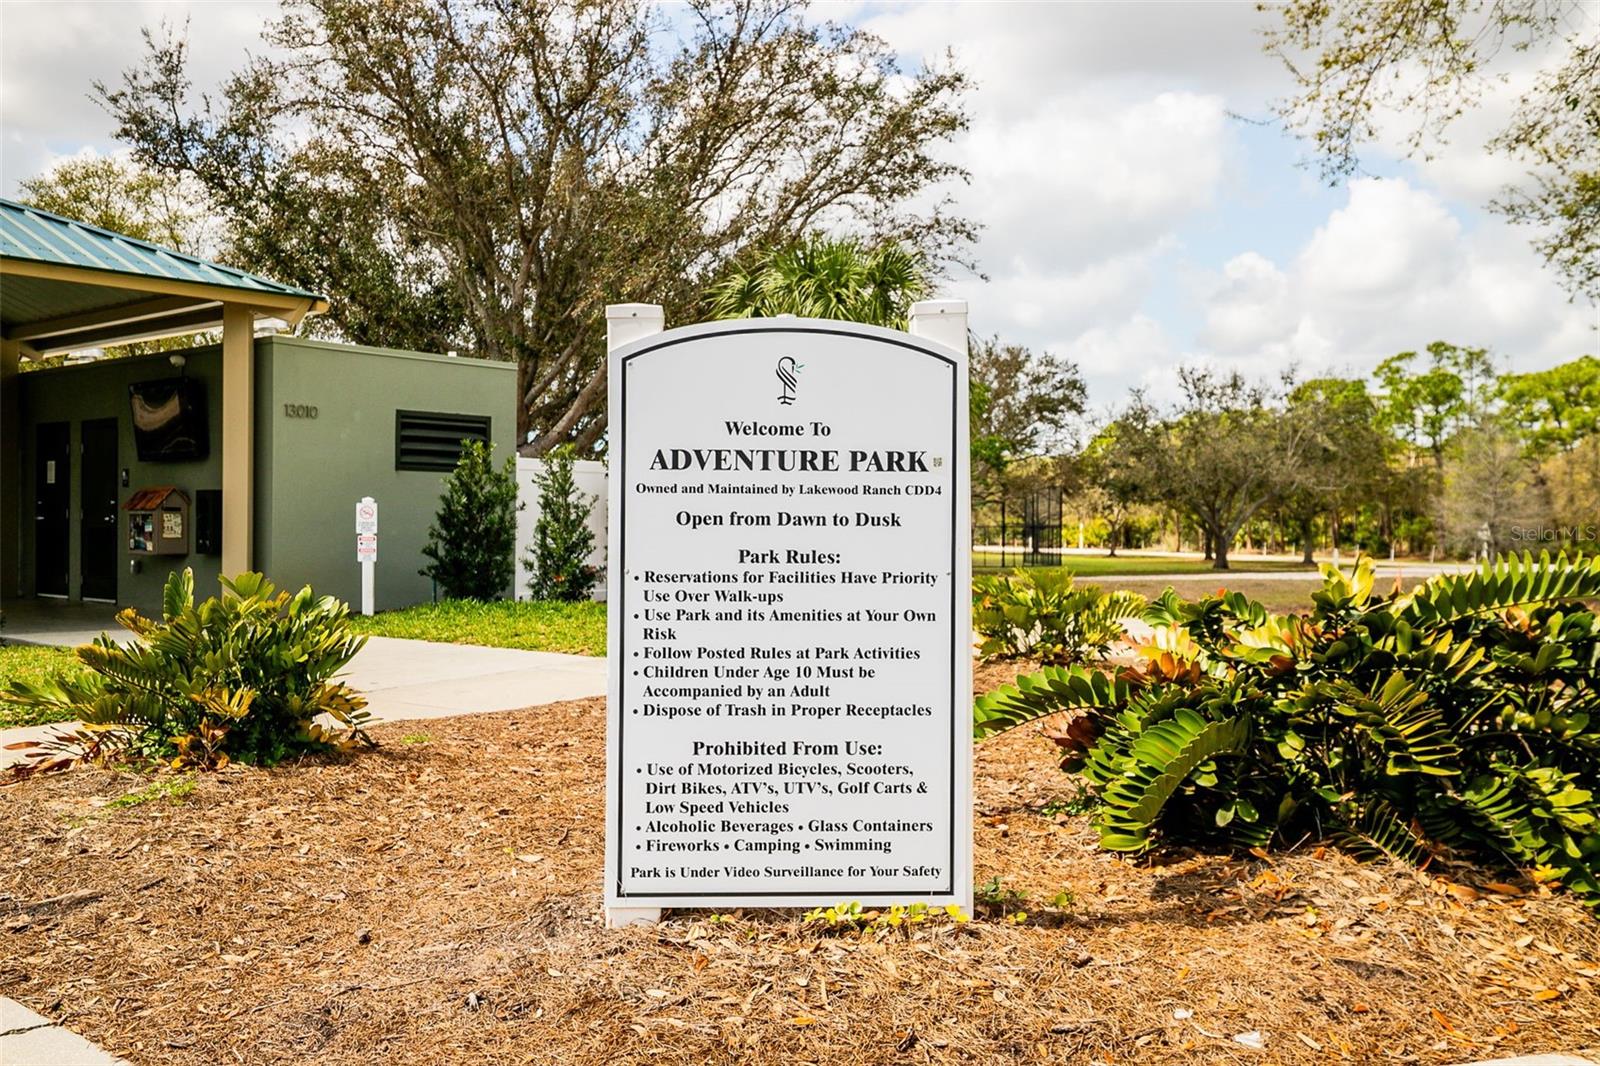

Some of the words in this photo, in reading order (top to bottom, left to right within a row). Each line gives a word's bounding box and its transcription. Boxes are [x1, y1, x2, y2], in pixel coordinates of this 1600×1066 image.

[283, 403, 319, 420] 13010
[724, 420, 805, 437] Welcome
[809, 421, 832, 437] To
[649, 448, 840, 473] ADVENTURE
[848, 449, 930, 473] PARK
[635, 482, 678, 494] Owned
[680, 483, 705, 494] and
[707, 483, 779, 495] Maintained
[781, 483, 796, 498] by
[798, 484, 859, 496] Lakewood
[862, 484, 902, 496] Ranch
[904, 484, 943, 496] CDD4
[675, 510, 724, 530] Open
[729, 510, 772, 527] from
[776, 511, 828, 527] Dawn
[832, 512, 850, 527] to
[855, 511, 902, 528] Dusk
[738, 548, 781, 565] Park
[785, 549, 841, 565] Rules:
[644, 570, 739, 584] Reservations
[742, 570, 765, 584] for
[768, 570, 837, 585] Facilities
[840, 571, 878, 585] Have
[881, 571, 939, 588] Priority
[643, 589, 671, 603] Use
[674, 589, 711, 603] Over
[713, 589, 784, 606] Walk-ups
[643, 608, 672, 622] Use
[675, 608, 711, 622] Park
[714, 608, 743, 622] and
[747, 608, 766, 622] its
[768, 608, 843, 622] Amenities
[846, 609, 862, 622] at
[864, 609, 900, 622] Your
[903, 609, 937, 623] Own
[642, 627, 677, 641] Risk
[643, 646, 692, 660] Follow
[696, 646, 746, 660] Posted
[750, 646, 792, 660] Rules
[795, 647, 811, 660] at
[814, 646, 850, 660] Park
[853, 646, 921, 660] Activities
[643, 665, 709, 679] Children
[713, 665, 760, 679] Under
[762, 665, 791, 682] Age
[796, 665, 813, 679] 10
[816, 665, 854, 679] Must
[858, 665, 876, 679] be
[642, 684, 743, 701] Accompanied
[746, 684, 764, 701] by
[767, 687, 786, 698] an
[789, 684, 831, 698] Adult
[643, 703, 702, 720] Dispose
[705, 703, 723, 717] of
[724, 703, 767, 717] Trash
[771, 703, 786, 717] in
[790, 703, 842, 720] Proper
[845, 703, 932, 720] Receptacles
[692, 740, 787, 757] Prohibited
[792, 740, 839, 756] From
[844, 740, 883, 756] Use:
[646, 762, 674, 776] Use
[677, 762, 695, 776] of
[697, 762, 774, 776] Motorized
[777, 762, 843, 779] Bicycles,
[846, 762, 914, 778] Scooters,
[645, 781, 677, 795] Dirt
[681, 781, 727, 797] Bikes,
[837, 781, 871, 795] Golf
[873, 781, 913, 795] Carts
[916, 780, 928, 794] &
[645, 801, 674, 814] Low
[679, 800, 725, 817] Speed
[728, 800, 790, 814] Vehicles
[645, 819, 716, 833] Alcoholic
[720, 819, 794, 836] Beverages
[807, 819, 849, 833] Glass
[852, 818, 934, 833] Containers
[646, 838, 720, 853] Fireworks
[733, 838, 801, 855] Camping
[814, 837, 892, 855] Swimming
[630, 866, 662, 879] Park
[664, 866, 677, 879] is
[680, 866, 721, 879] Under
[723, 866, 761, 878] Video
[763, 865, 844, 878] Surveillance
[847, 865, 867, 878] for
[869, 865, 900, 877] Your
[902, 865, 942, 880] Safety
